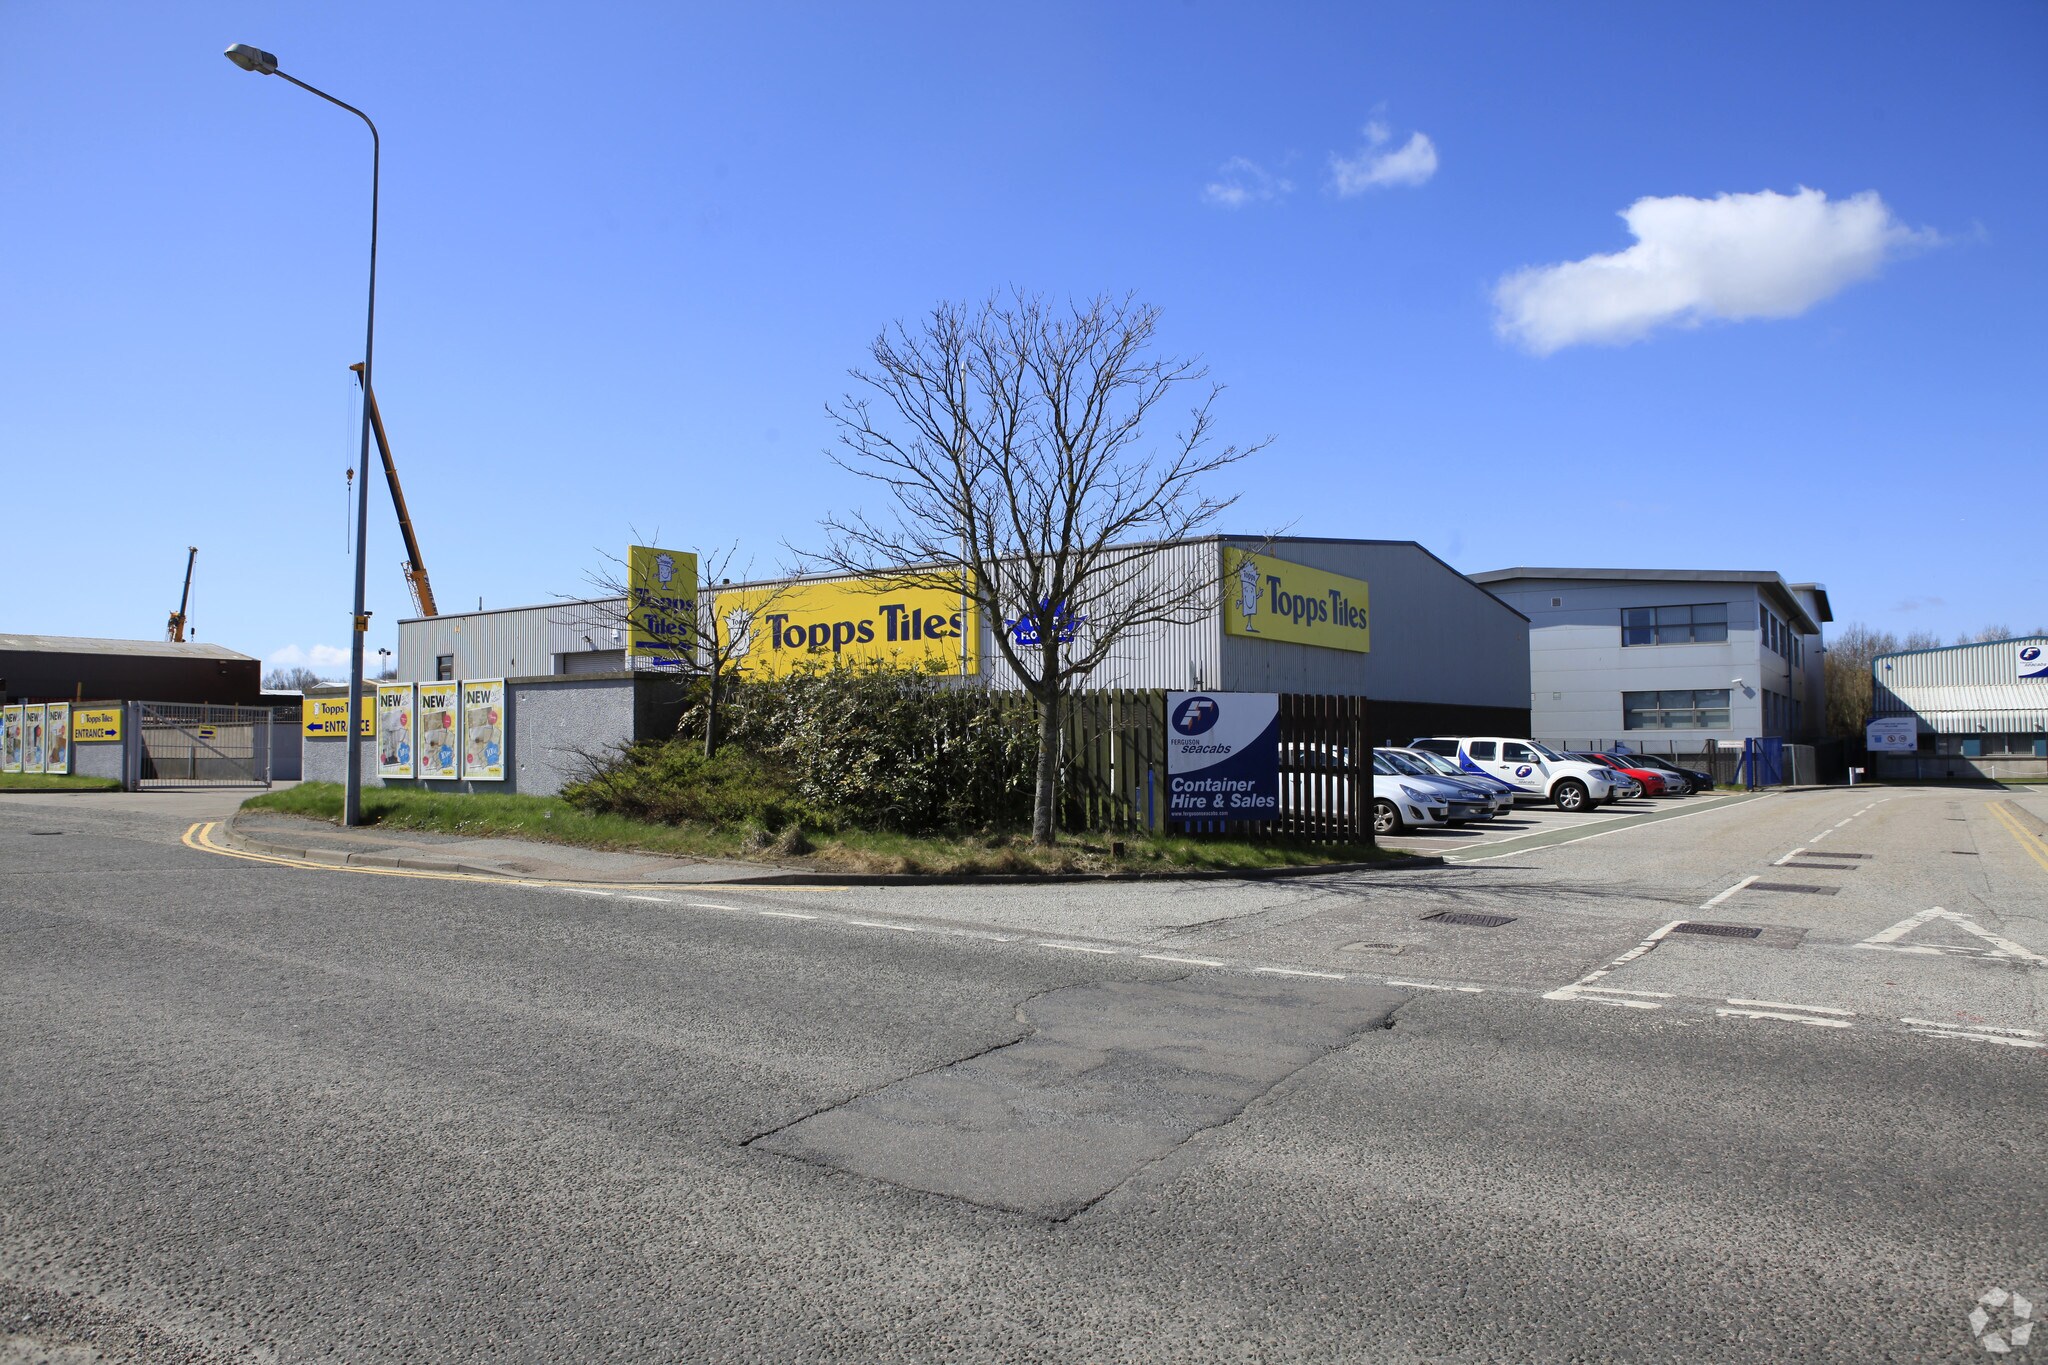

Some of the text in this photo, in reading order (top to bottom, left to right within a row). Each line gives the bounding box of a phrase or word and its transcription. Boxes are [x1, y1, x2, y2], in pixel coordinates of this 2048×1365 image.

[635, 587, 694, 614] Topps
[1266, 575, 1367, 630] Topps Tiles
[643, 614, 687, 636] Tiles
[765, 603, 968, 652] Topps Tiles
[380, 694, 402, 708] NEW
[422, 695, 446, 708] NEW
[467, 690, 491, 704] NEW
[321, 703, 345, 715] Topps
[5, 713, 18, 723] NEW
[27, 712, 39, 722] NEW
[50, 711, 63, 721] NEW
[86, 713, 113, 724] Topps Tiles
[324, 720, 370, 733] ENTRCE
[75, 728, 104, 739] ENTRANCE
[1181, 743, 1232, 754] seacabs
[1171, 777, 1255, 792] Container
[1171, 793, 1275, 808] Hire & Sales
